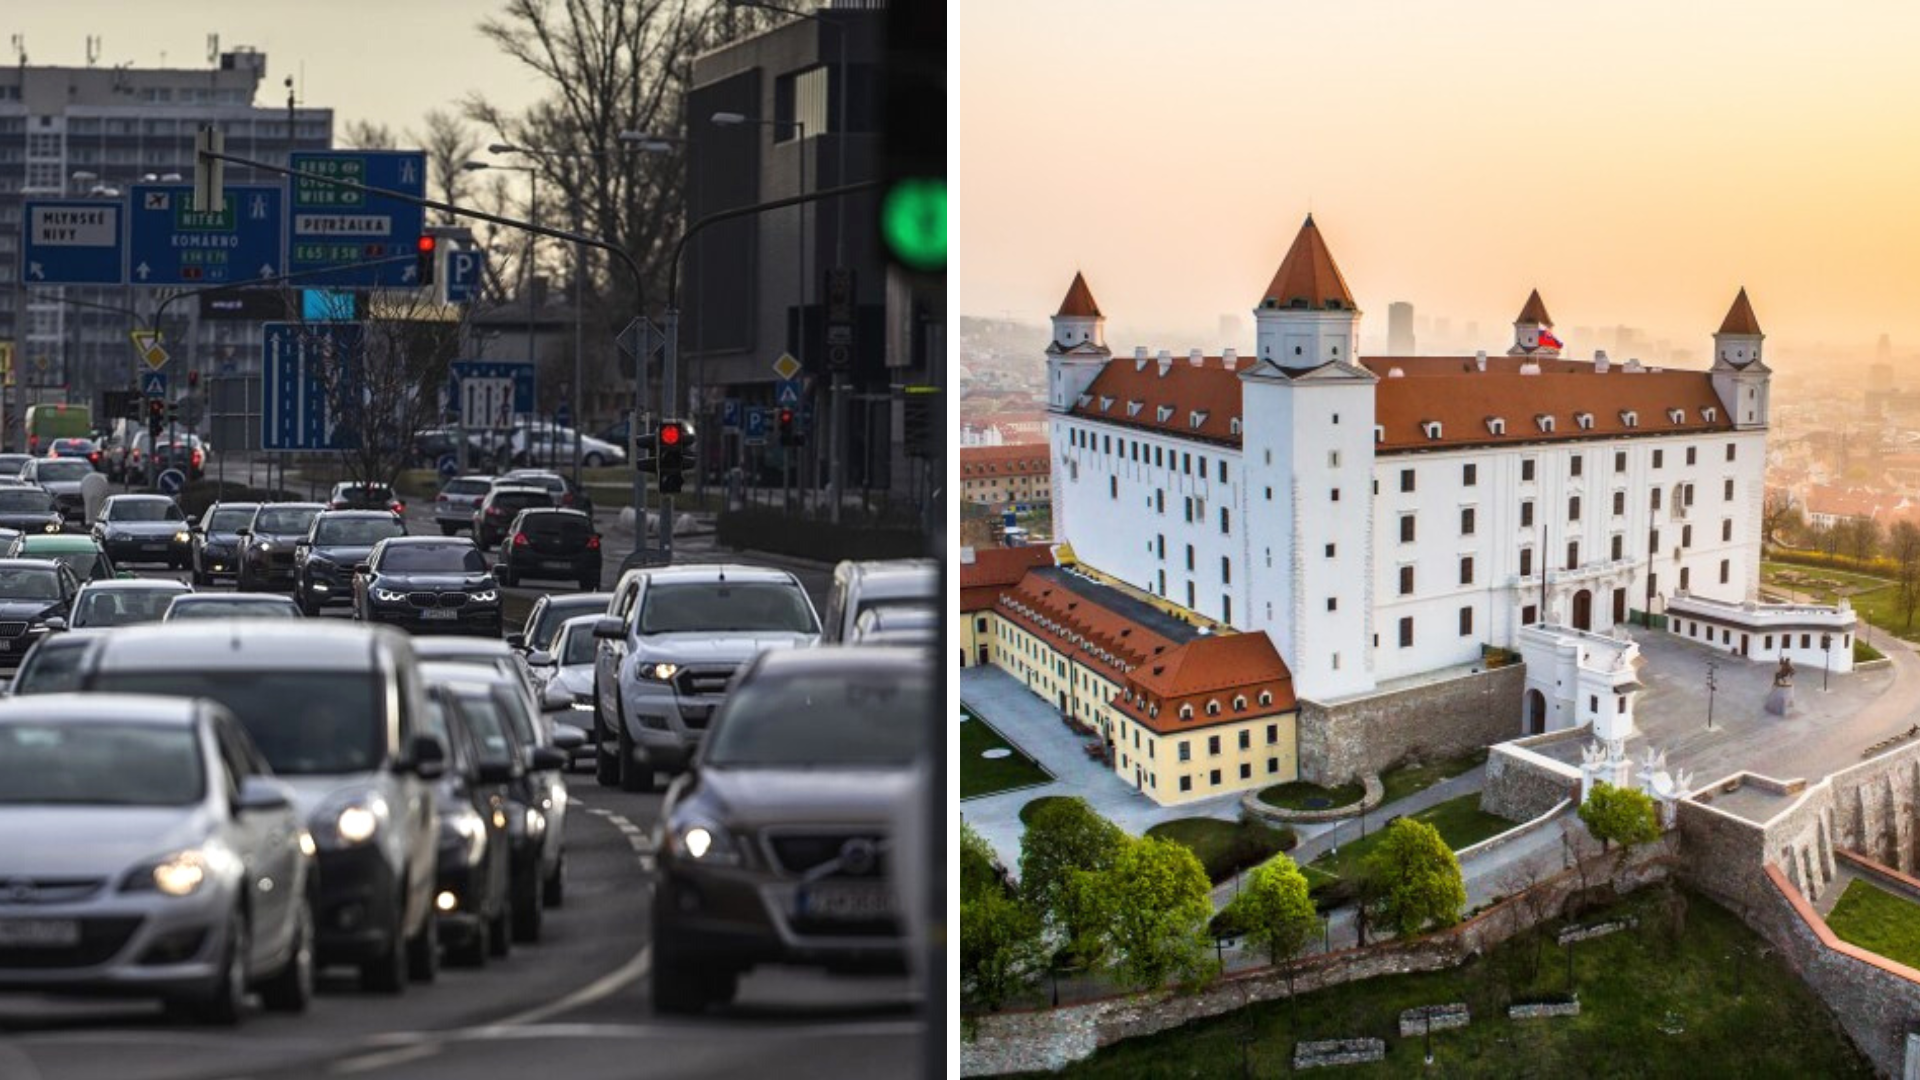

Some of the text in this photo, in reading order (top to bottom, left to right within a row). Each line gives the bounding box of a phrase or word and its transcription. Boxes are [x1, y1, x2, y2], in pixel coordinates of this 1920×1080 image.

[301, 161, 338, 174] BRNO
[301, 191, 336, 203] WIEN
[44, 211, 104, 225] MLYNSKÉ
[183, 213, 225, 225] NITRA
[303, 216, 384, 230] PETRŽALKA
[43, 229, 76, 240] NIVY
[171, 233, 239, 247] KOMÁRNO
[297, 246, 323, 259] E65
[456, 255, 472, 282] P
[750, 413, 761, 430] P
